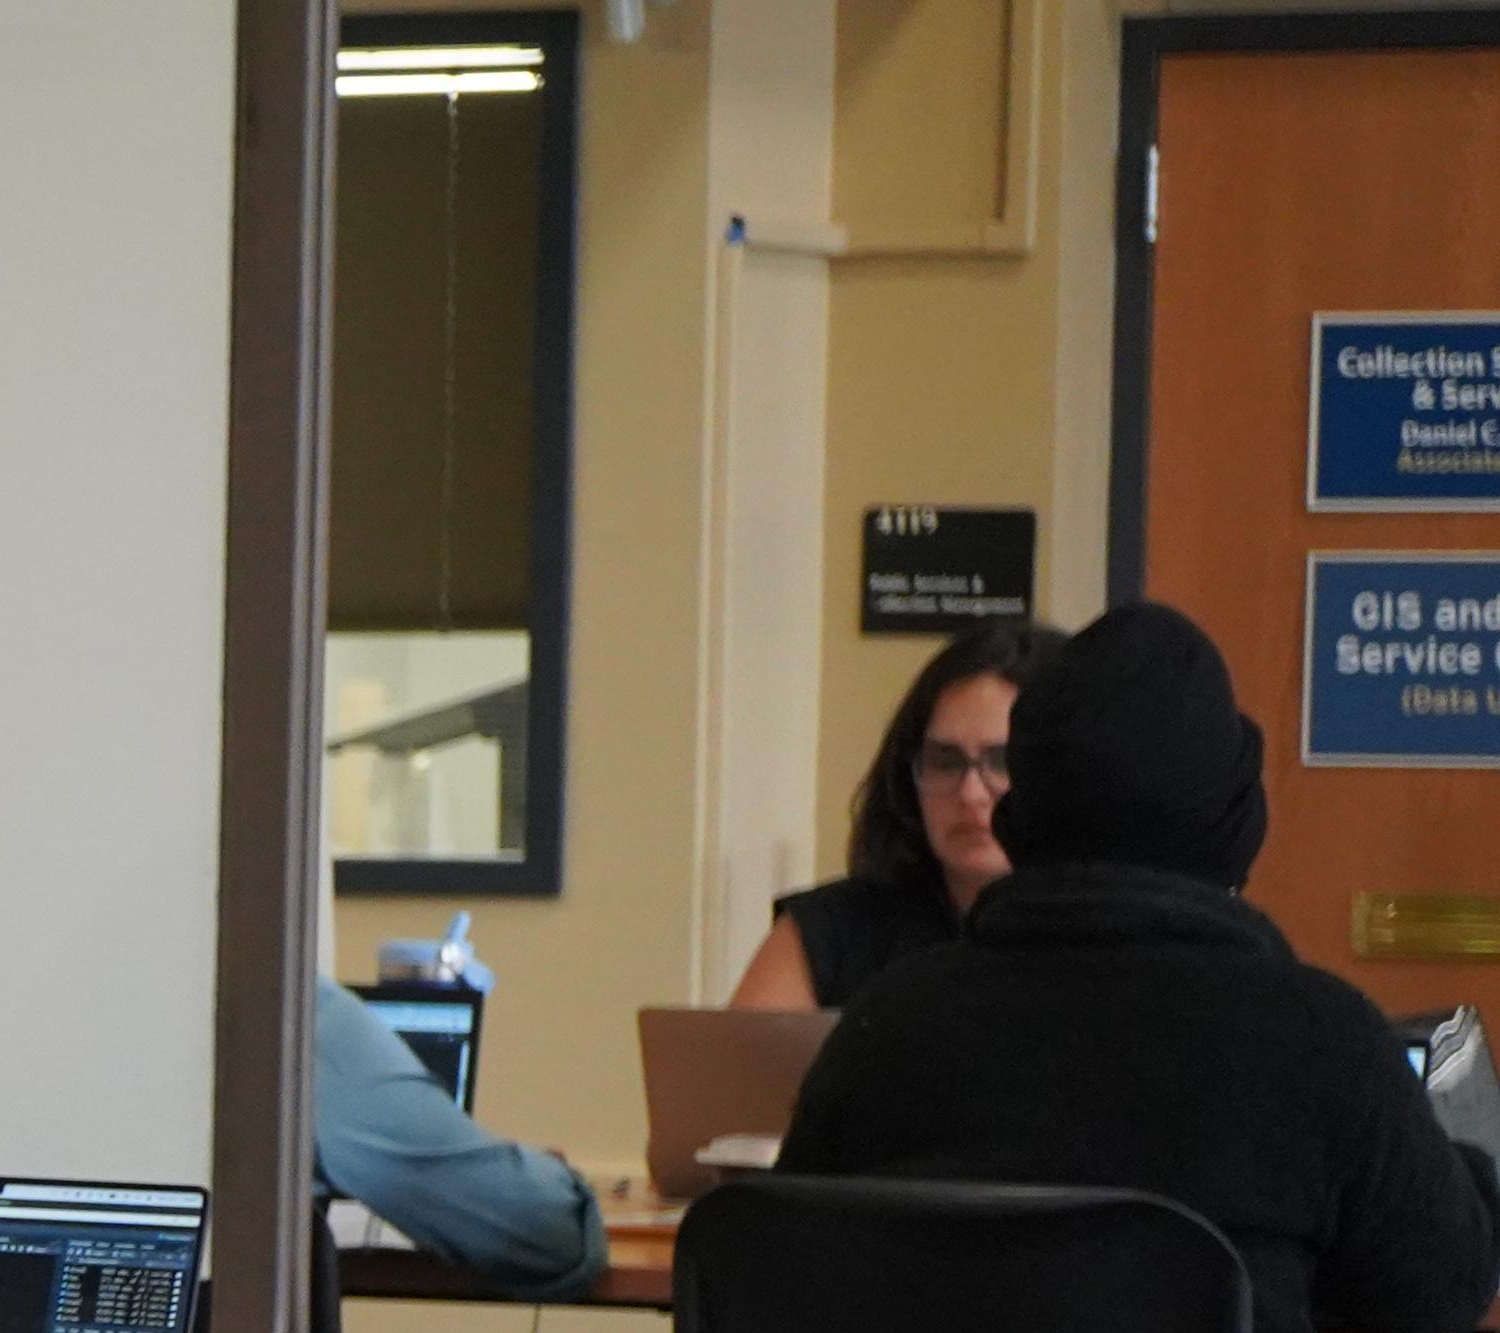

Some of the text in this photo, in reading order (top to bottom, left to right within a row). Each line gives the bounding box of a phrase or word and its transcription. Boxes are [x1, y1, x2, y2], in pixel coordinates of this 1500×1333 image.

[1337, 345, 1486, 378] Collection
[1412, 378, 1436, 410] &
[1353, 590, 1500, 631] GIS and
[1336, 633, 1482, 675] Service
